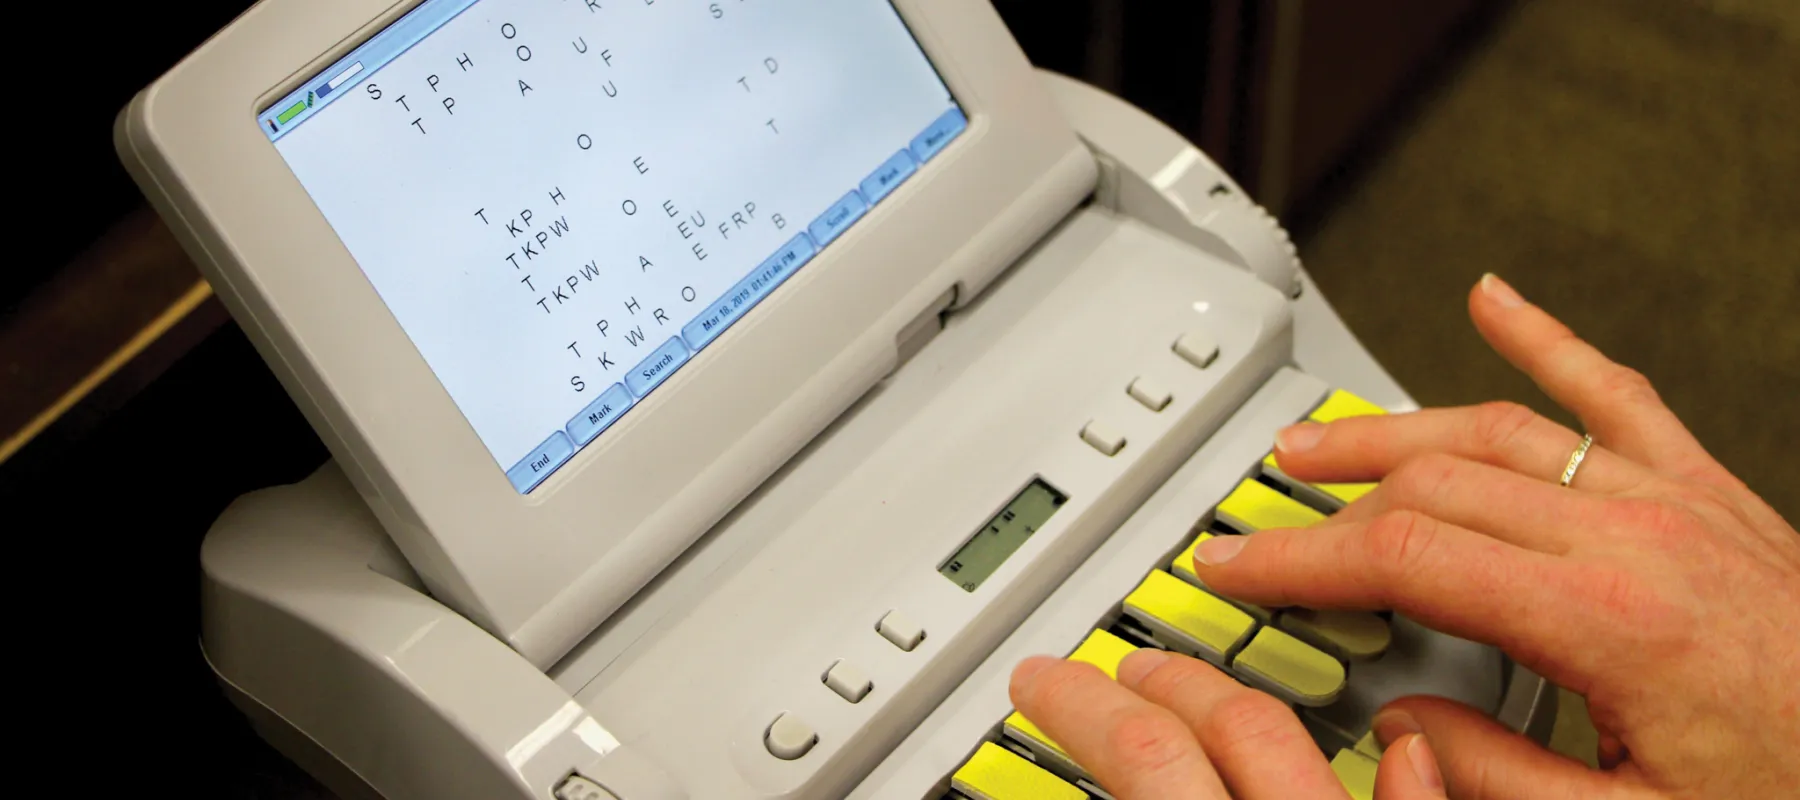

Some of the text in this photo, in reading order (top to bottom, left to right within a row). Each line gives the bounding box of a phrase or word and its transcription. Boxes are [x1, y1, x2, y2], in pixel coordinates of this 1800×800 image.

[394, 22, 517, 113] T P H O
[517, 36, 588, 98] A U
[600, 48, 613, 68] F
[601, 3, 724, 99] U S
[366, 83, 383, 101] S
[410, 116, 427, 135] T
[441, 96, 456, 116] P
[515, 44, 532, 62] O
[632, 155, 650, 176] E
[737, 74, 751, 93] T
[763, 56, 779, 75] D
[473, 133, 593, 226] T O
[548, 186, 566, 207] H
[662, 199, 680, 219] E
[765, 117, 779, 135] T
[520, 199, 638, 293] T O
[638, 255, 654, 273] A
[566, 340, 582, 359] T
[595, 318, 609, 338] P
[623, 295, 642, 316] H
[691, 242, 709, 262] E
[570, 212, 787, 393] S K W R O B
[702, 315, 720, 331] Mar
[731, 288, 750, 308] 2019
[642, 354, 673, 381] Search
[588, 404, 612, 425] Mark
[530, 453, 550, 473] End
